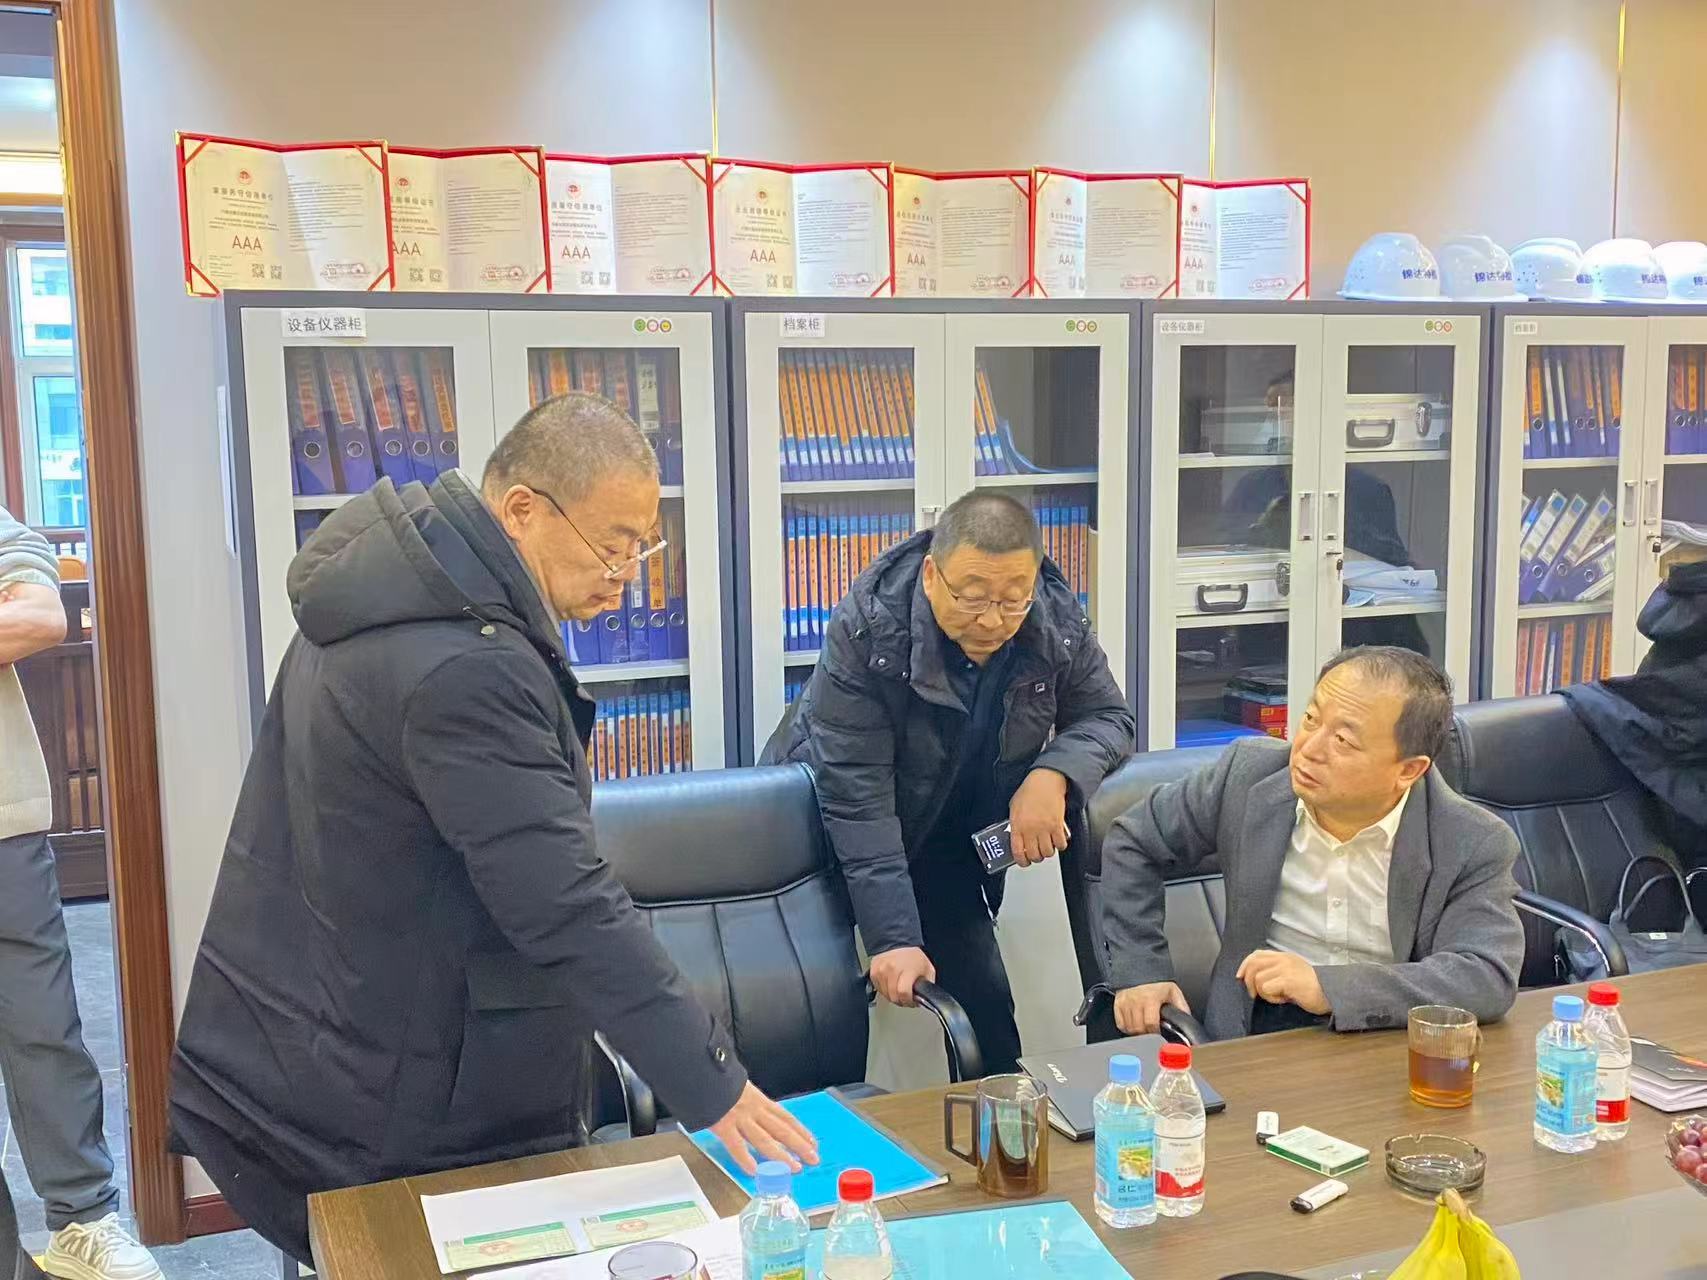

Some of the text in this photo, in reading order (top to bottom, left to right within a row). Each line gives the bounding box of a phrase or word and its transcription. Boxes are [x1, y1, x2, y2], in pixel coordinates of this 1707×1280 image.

[232, 235, 263, 253] AAA
[392, 241, 422, 256] AAA
[562, 245, 591, 260] AAA
[750, 249, 777, 263] AAA
[907, 252, 926, 266] AAA
[1058, 254, 1076, 266] AAA
[1184, 256, 1204, 270] AAA
[287, 316, 362, 333] 设备仪器柜
[784, 317, 821, 331] 档案柜
[1161, 321, 1203, 332] 设备仪器柜
[988, 835, 1005, 859] 17:10
